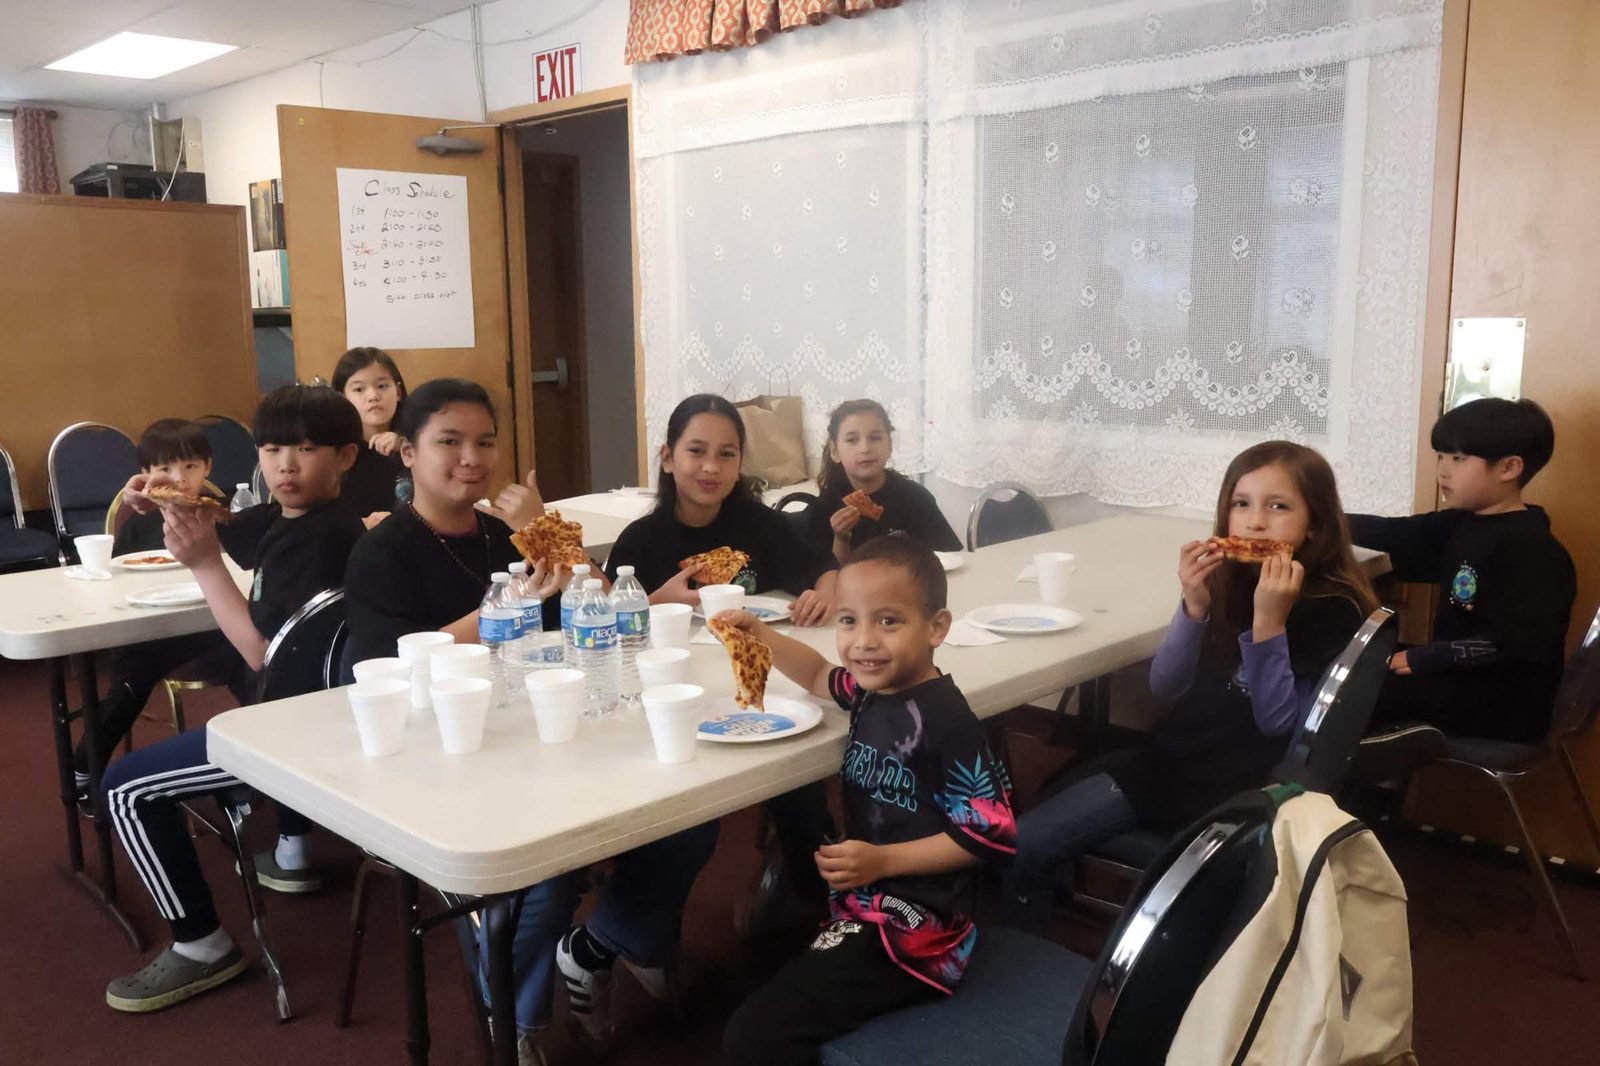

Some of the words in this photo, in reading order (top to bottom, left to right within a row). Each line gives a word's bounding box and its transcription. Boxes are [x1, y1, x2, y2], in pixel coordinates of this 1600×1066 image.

[536, 47, 576, 102] EXIT
[364, 179, 401, 197] Class
[381, 222, 405, 233] 2:00
